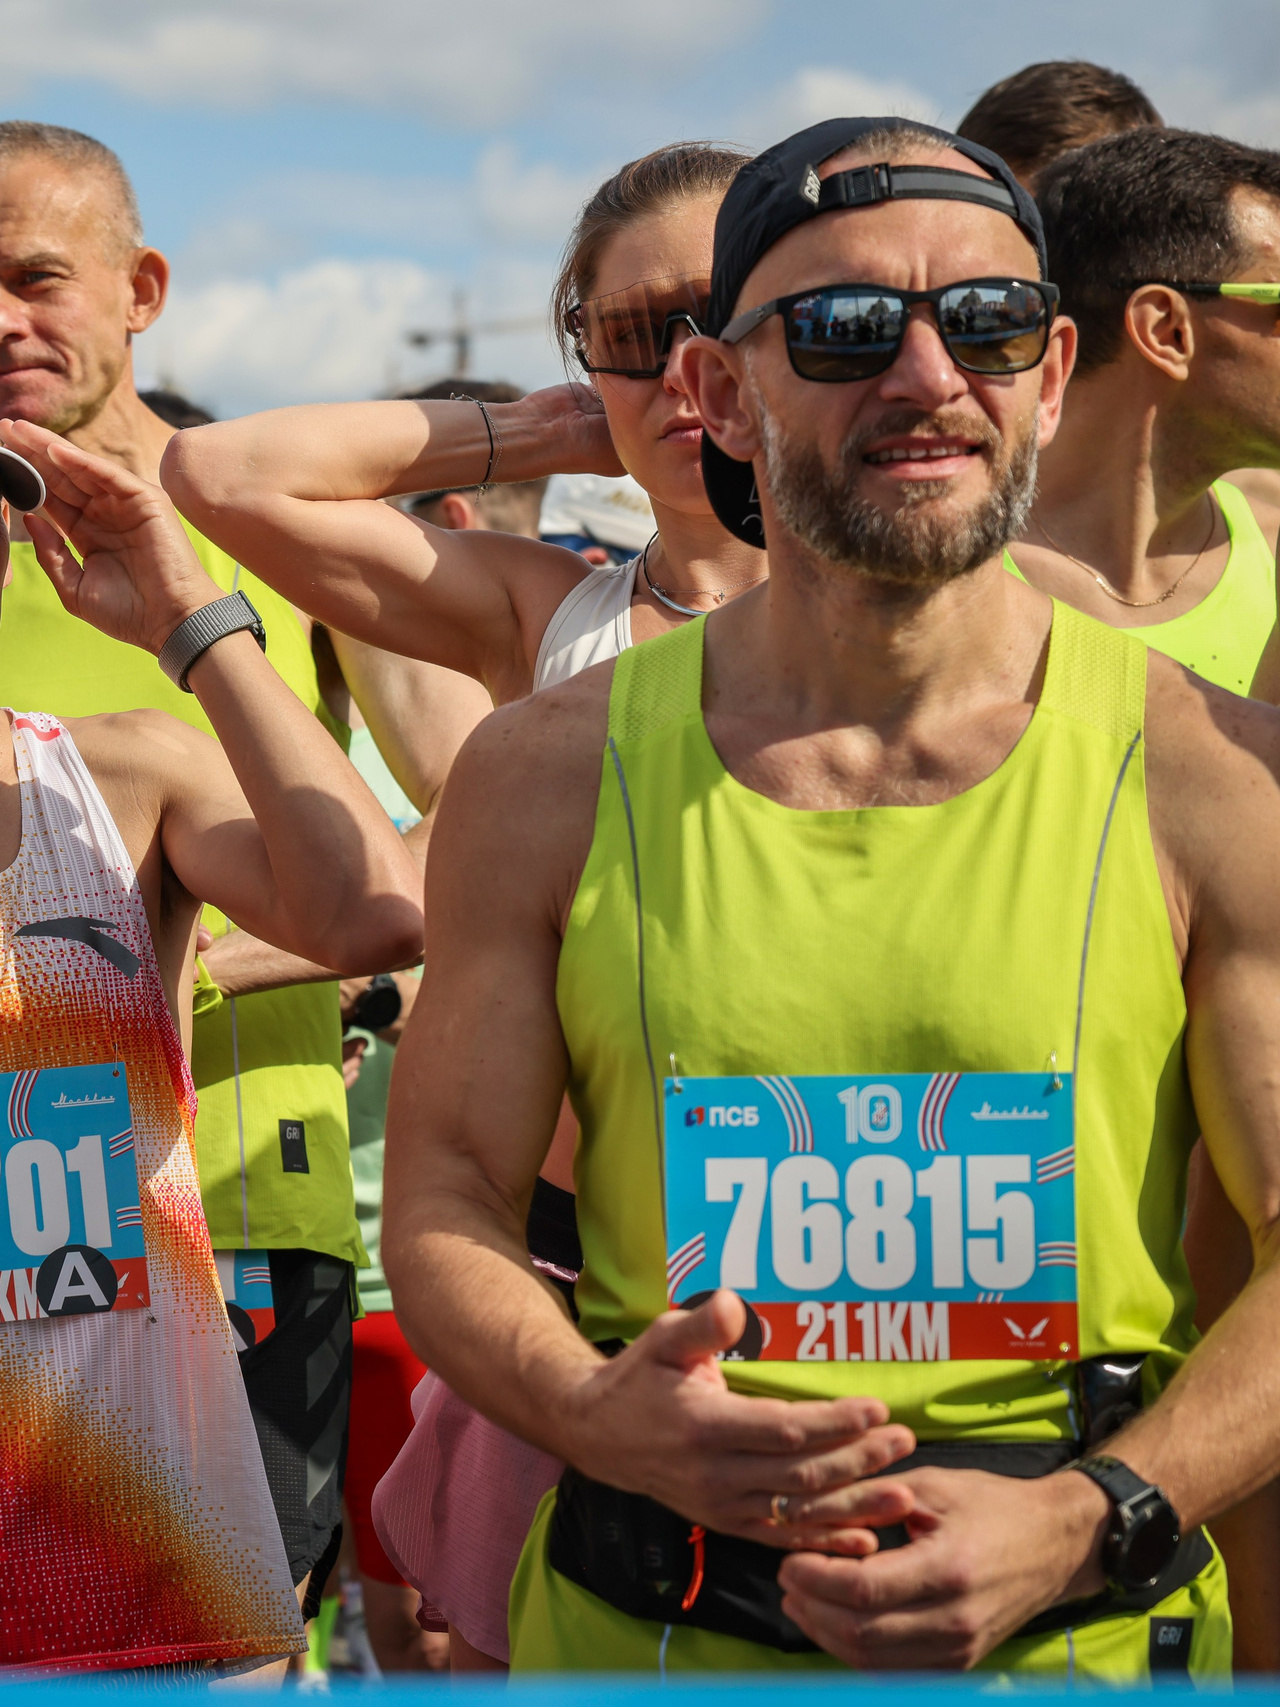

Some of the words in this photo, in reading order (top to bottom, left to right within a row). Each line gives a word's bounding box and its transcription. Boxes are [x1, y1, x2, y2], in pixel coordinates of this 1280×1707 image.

[708, 1105, 760, 1128] ПСБ
[836, 1083, 903, 1144] 10
[704, 1153, 1036, 1291] 76815
[47, 1251, 110, 1311] A
